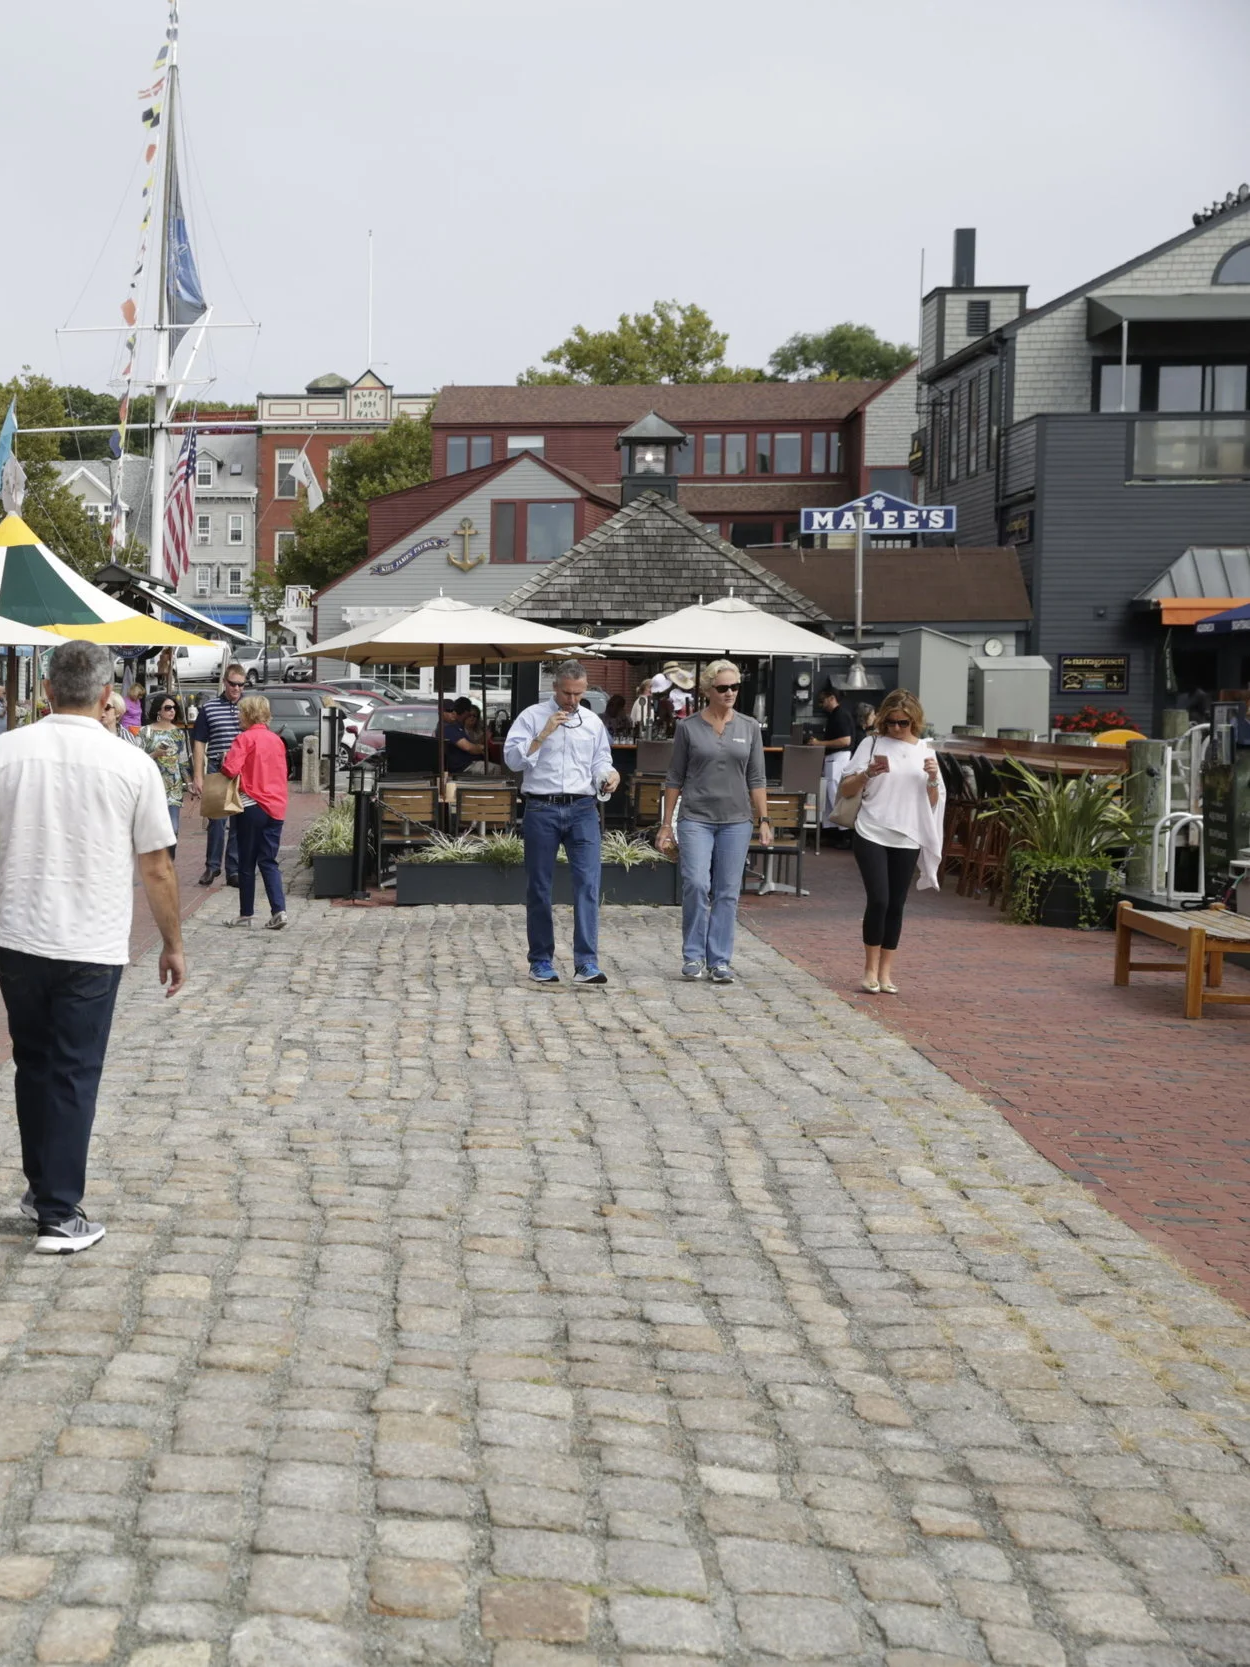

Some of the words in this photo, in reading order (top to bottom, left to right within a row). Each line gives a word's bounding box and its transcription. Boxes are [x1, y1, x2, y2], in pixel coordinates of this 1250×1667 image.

[353, 391, 385, 401] MUSIC
[356, 410, 381, 418] HALL
[811, 510, 945, 530] MALEE'S
